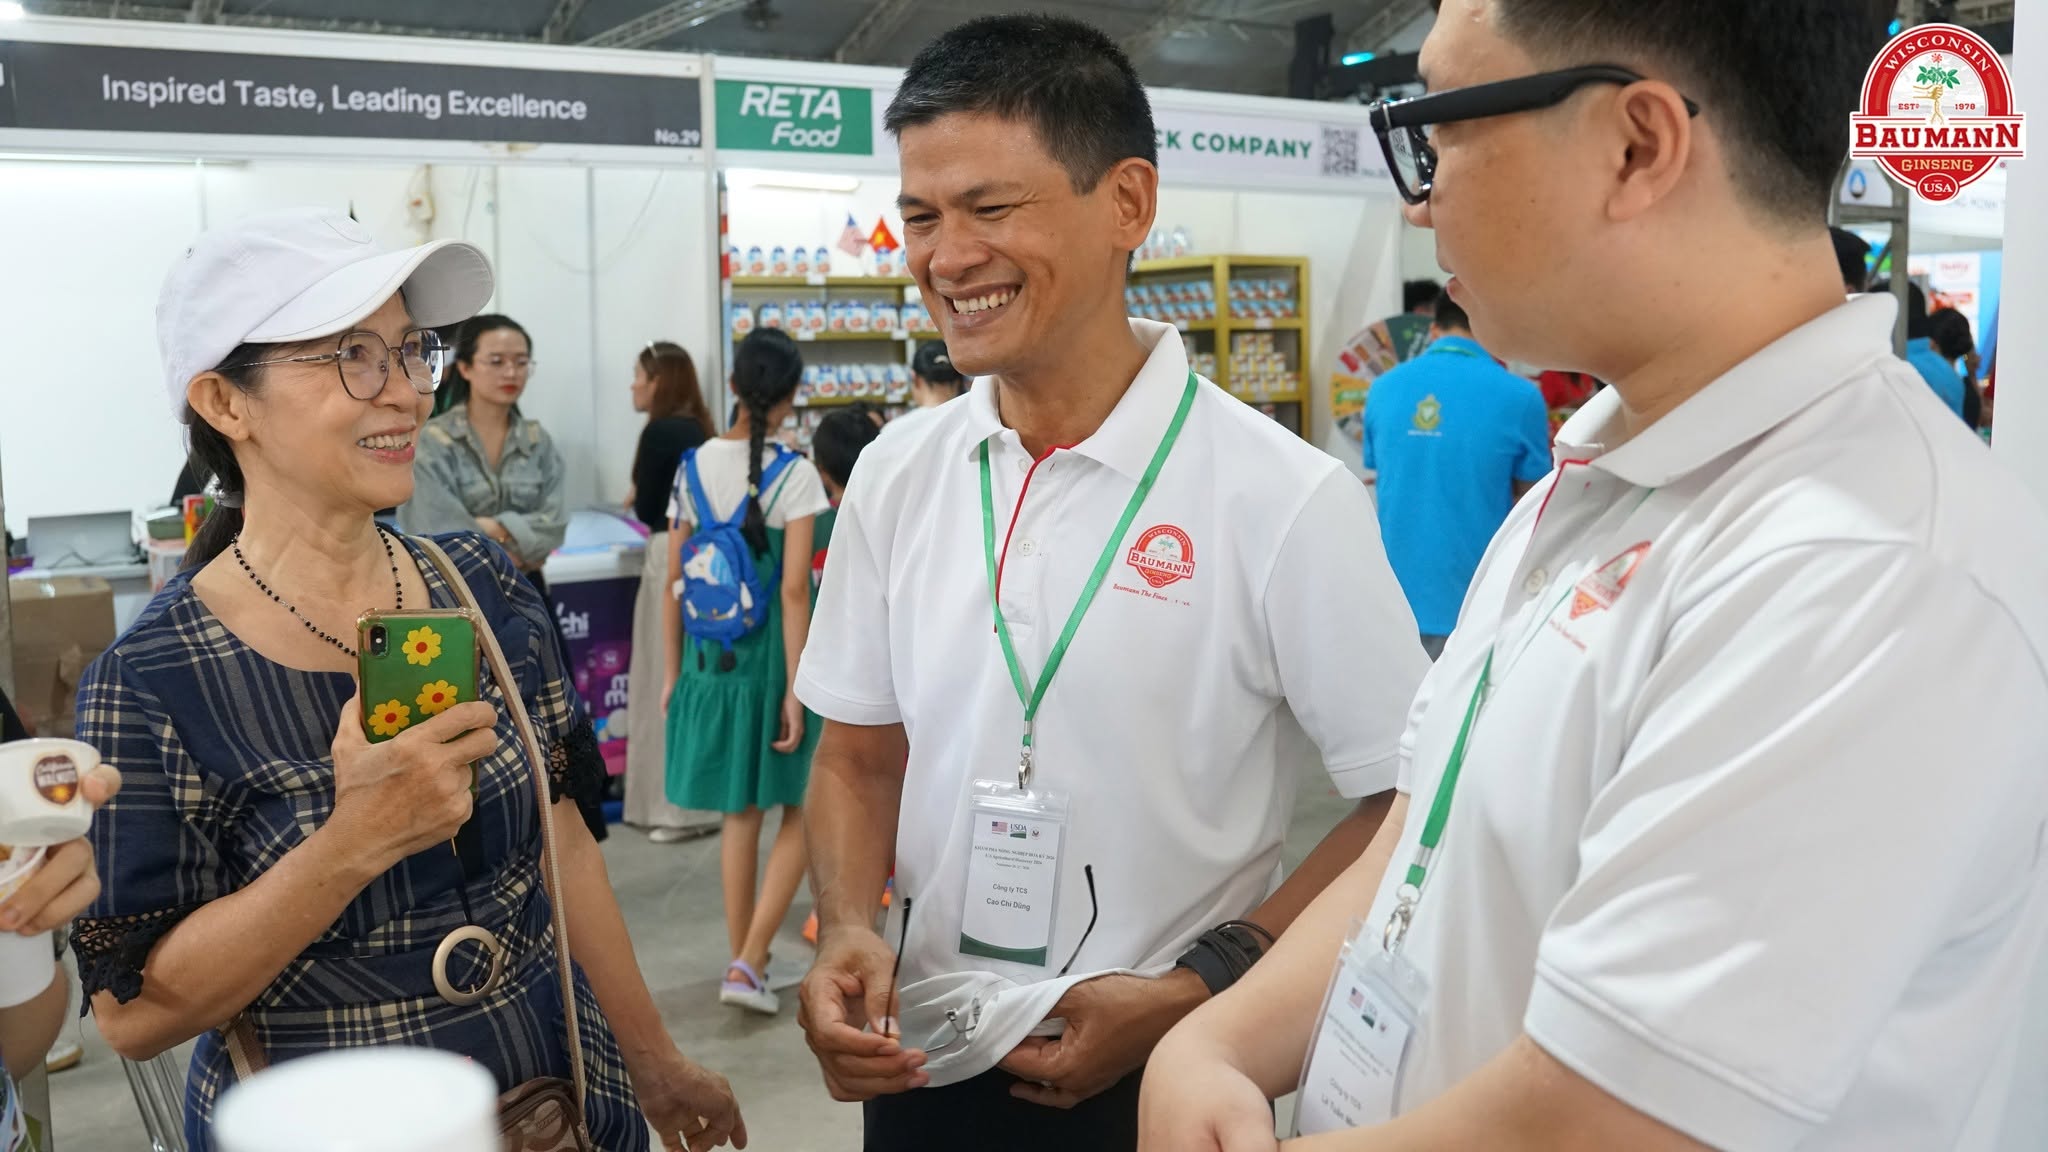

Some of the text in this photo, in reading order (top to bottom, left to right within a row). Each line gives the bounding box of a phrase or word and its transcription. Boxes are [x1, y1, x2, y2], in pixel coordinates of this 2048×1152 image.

[102, 74, 588, 120] Inspired Taste, Leading Excellence
[739, 83, 842, 121] RETA
[654, 128, 700, 146] No.29
[771, 121, 842, 148] Food
[1191, 132, 1313, 159] COMPANY
[1130, 552, 1192, 575] BAUMANN
[1141, 589, 1152, 598] The
[986, 897, 999, 906] Cao
[1016, 887, 1028, 895] TCS
